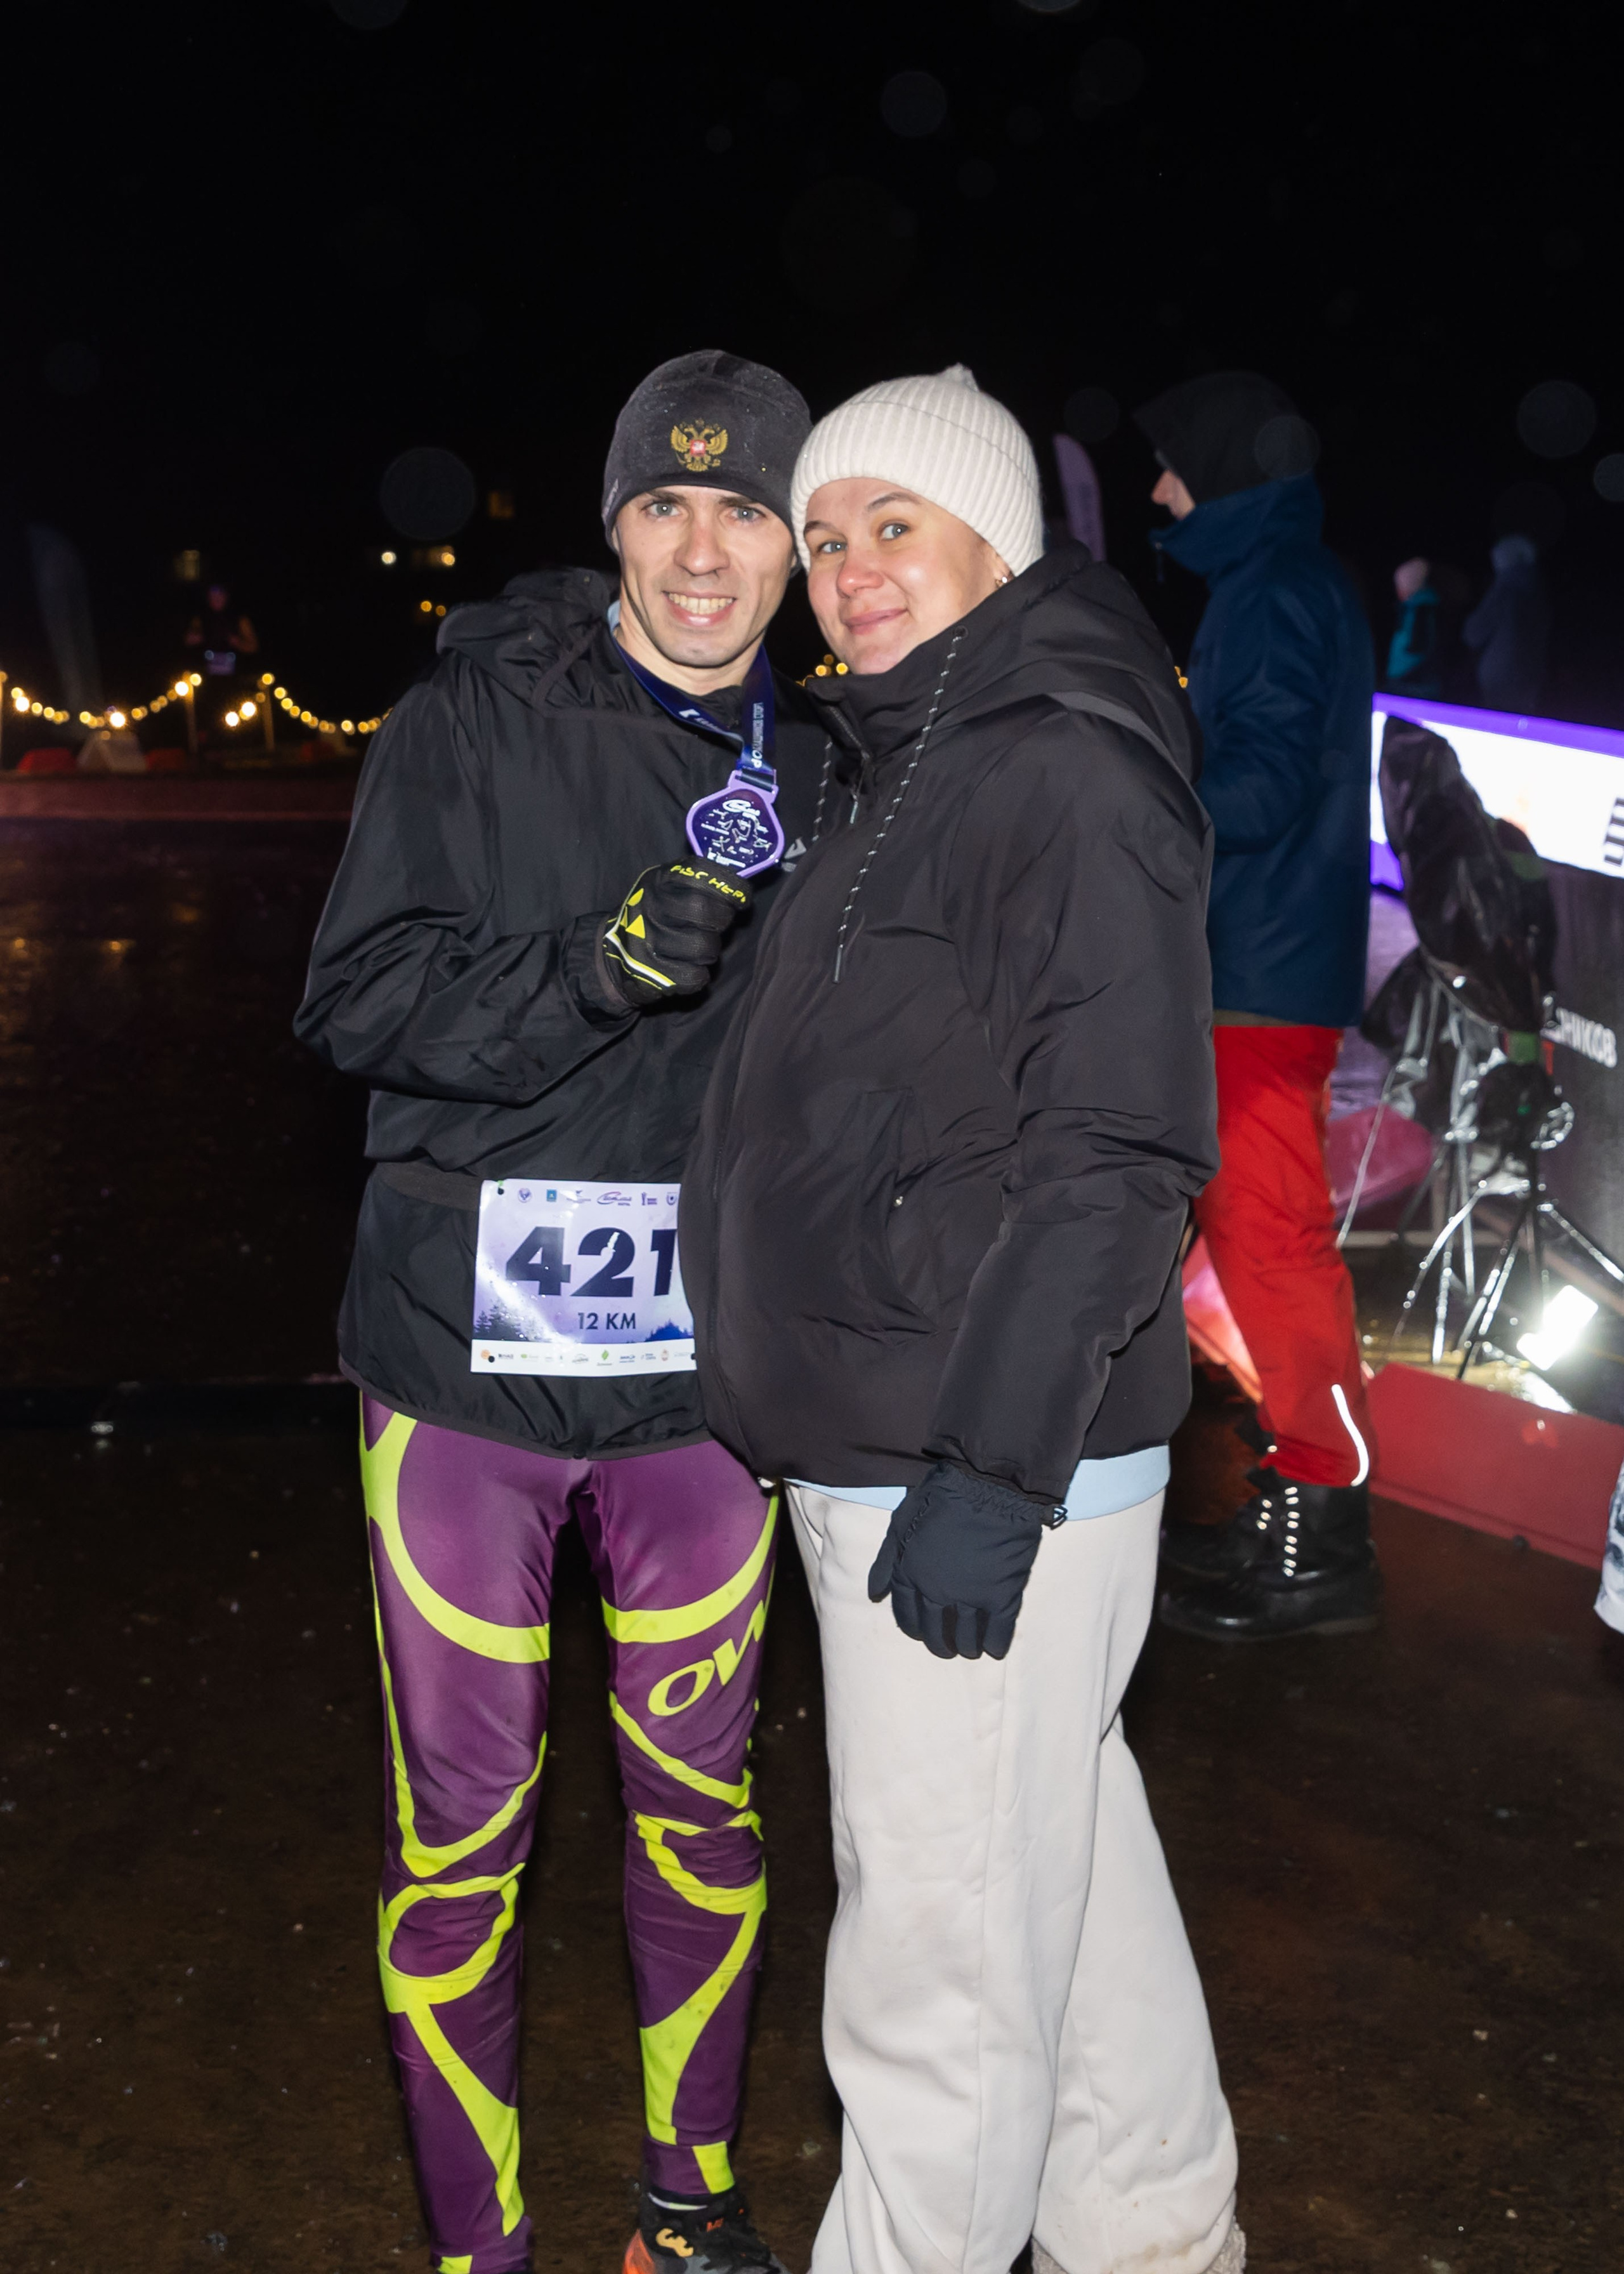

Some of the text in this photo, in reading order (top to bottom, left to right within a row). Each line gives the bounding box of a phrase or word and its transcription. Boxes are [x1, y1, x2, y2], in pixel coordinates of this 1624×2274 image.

[506, 1226, 677, 1298] 421
[577, 1311, 637, 1331] 12 KM
